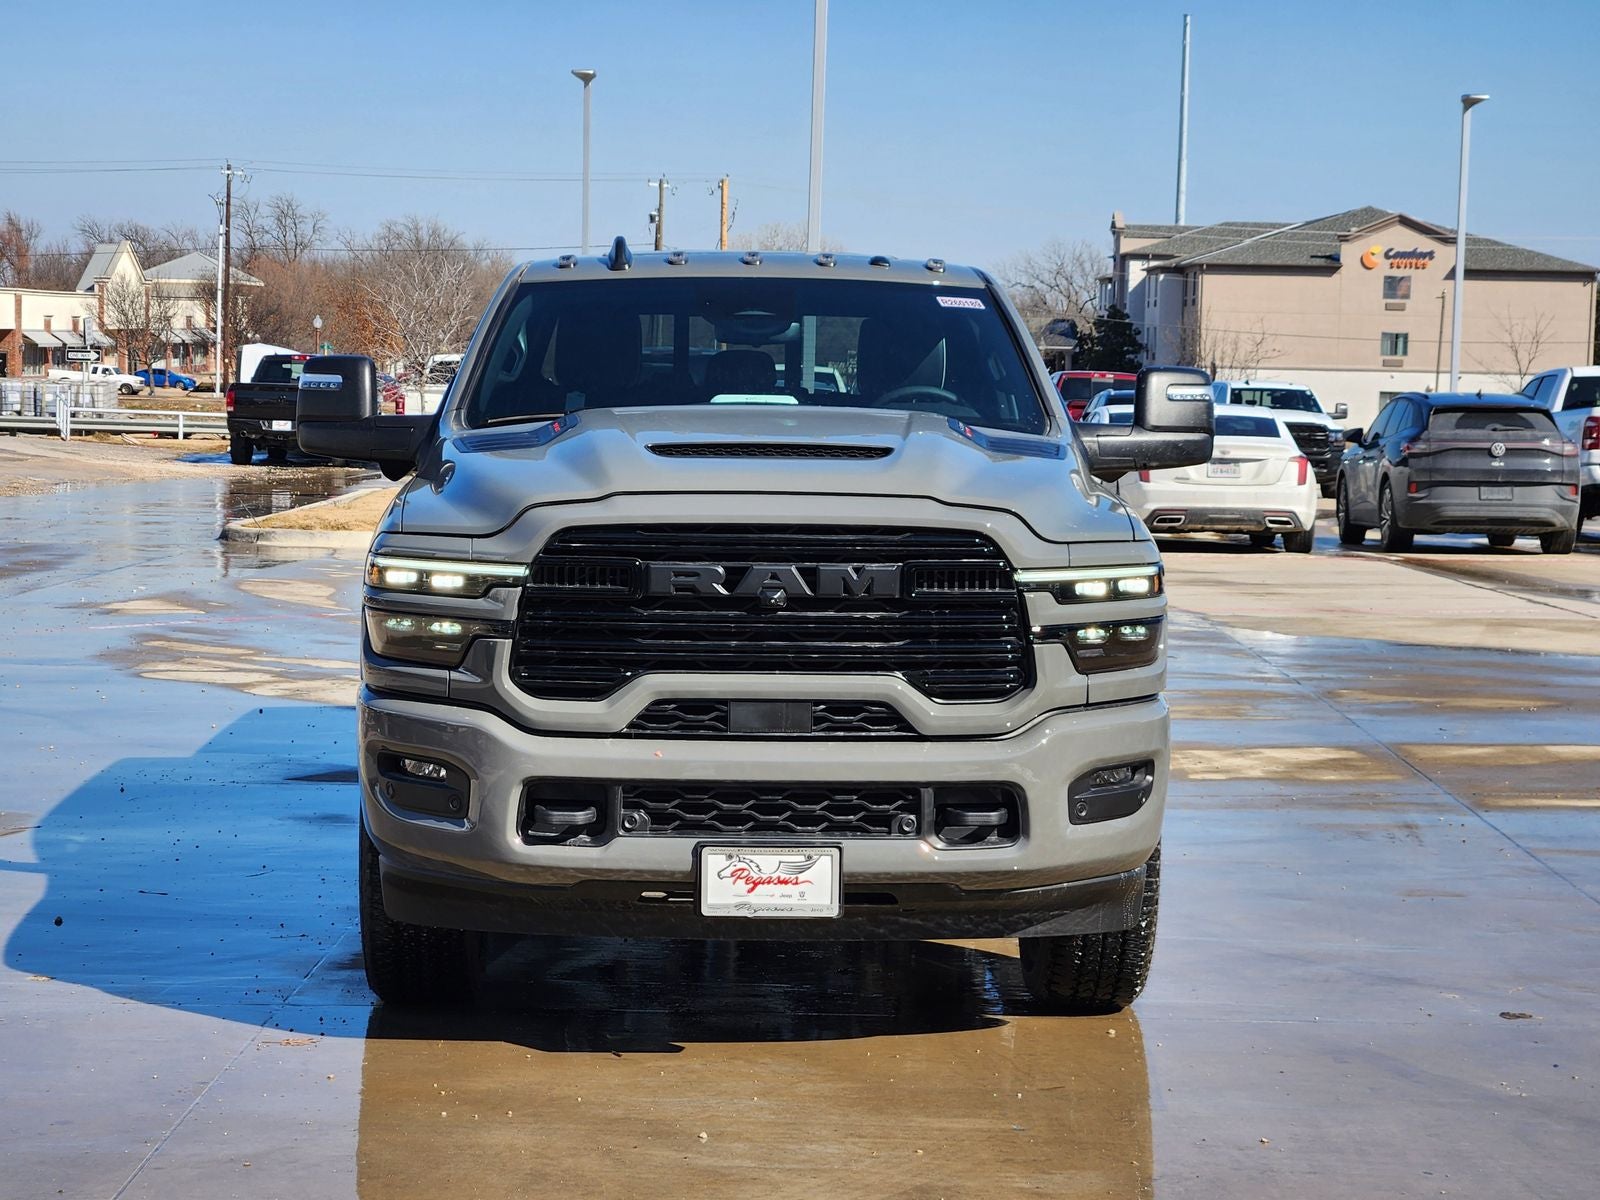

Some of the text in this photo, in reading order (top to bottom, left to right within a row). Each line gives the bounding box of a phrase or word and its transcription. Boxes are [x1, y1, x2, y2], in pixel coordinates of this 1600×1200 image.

[1384, 247, 1435, 260] Comfort
[1389, 259, 1427, 270] SUITES
[647, 561, 901, 598] RAM
[730, 867, 814, 894] Pegasus
